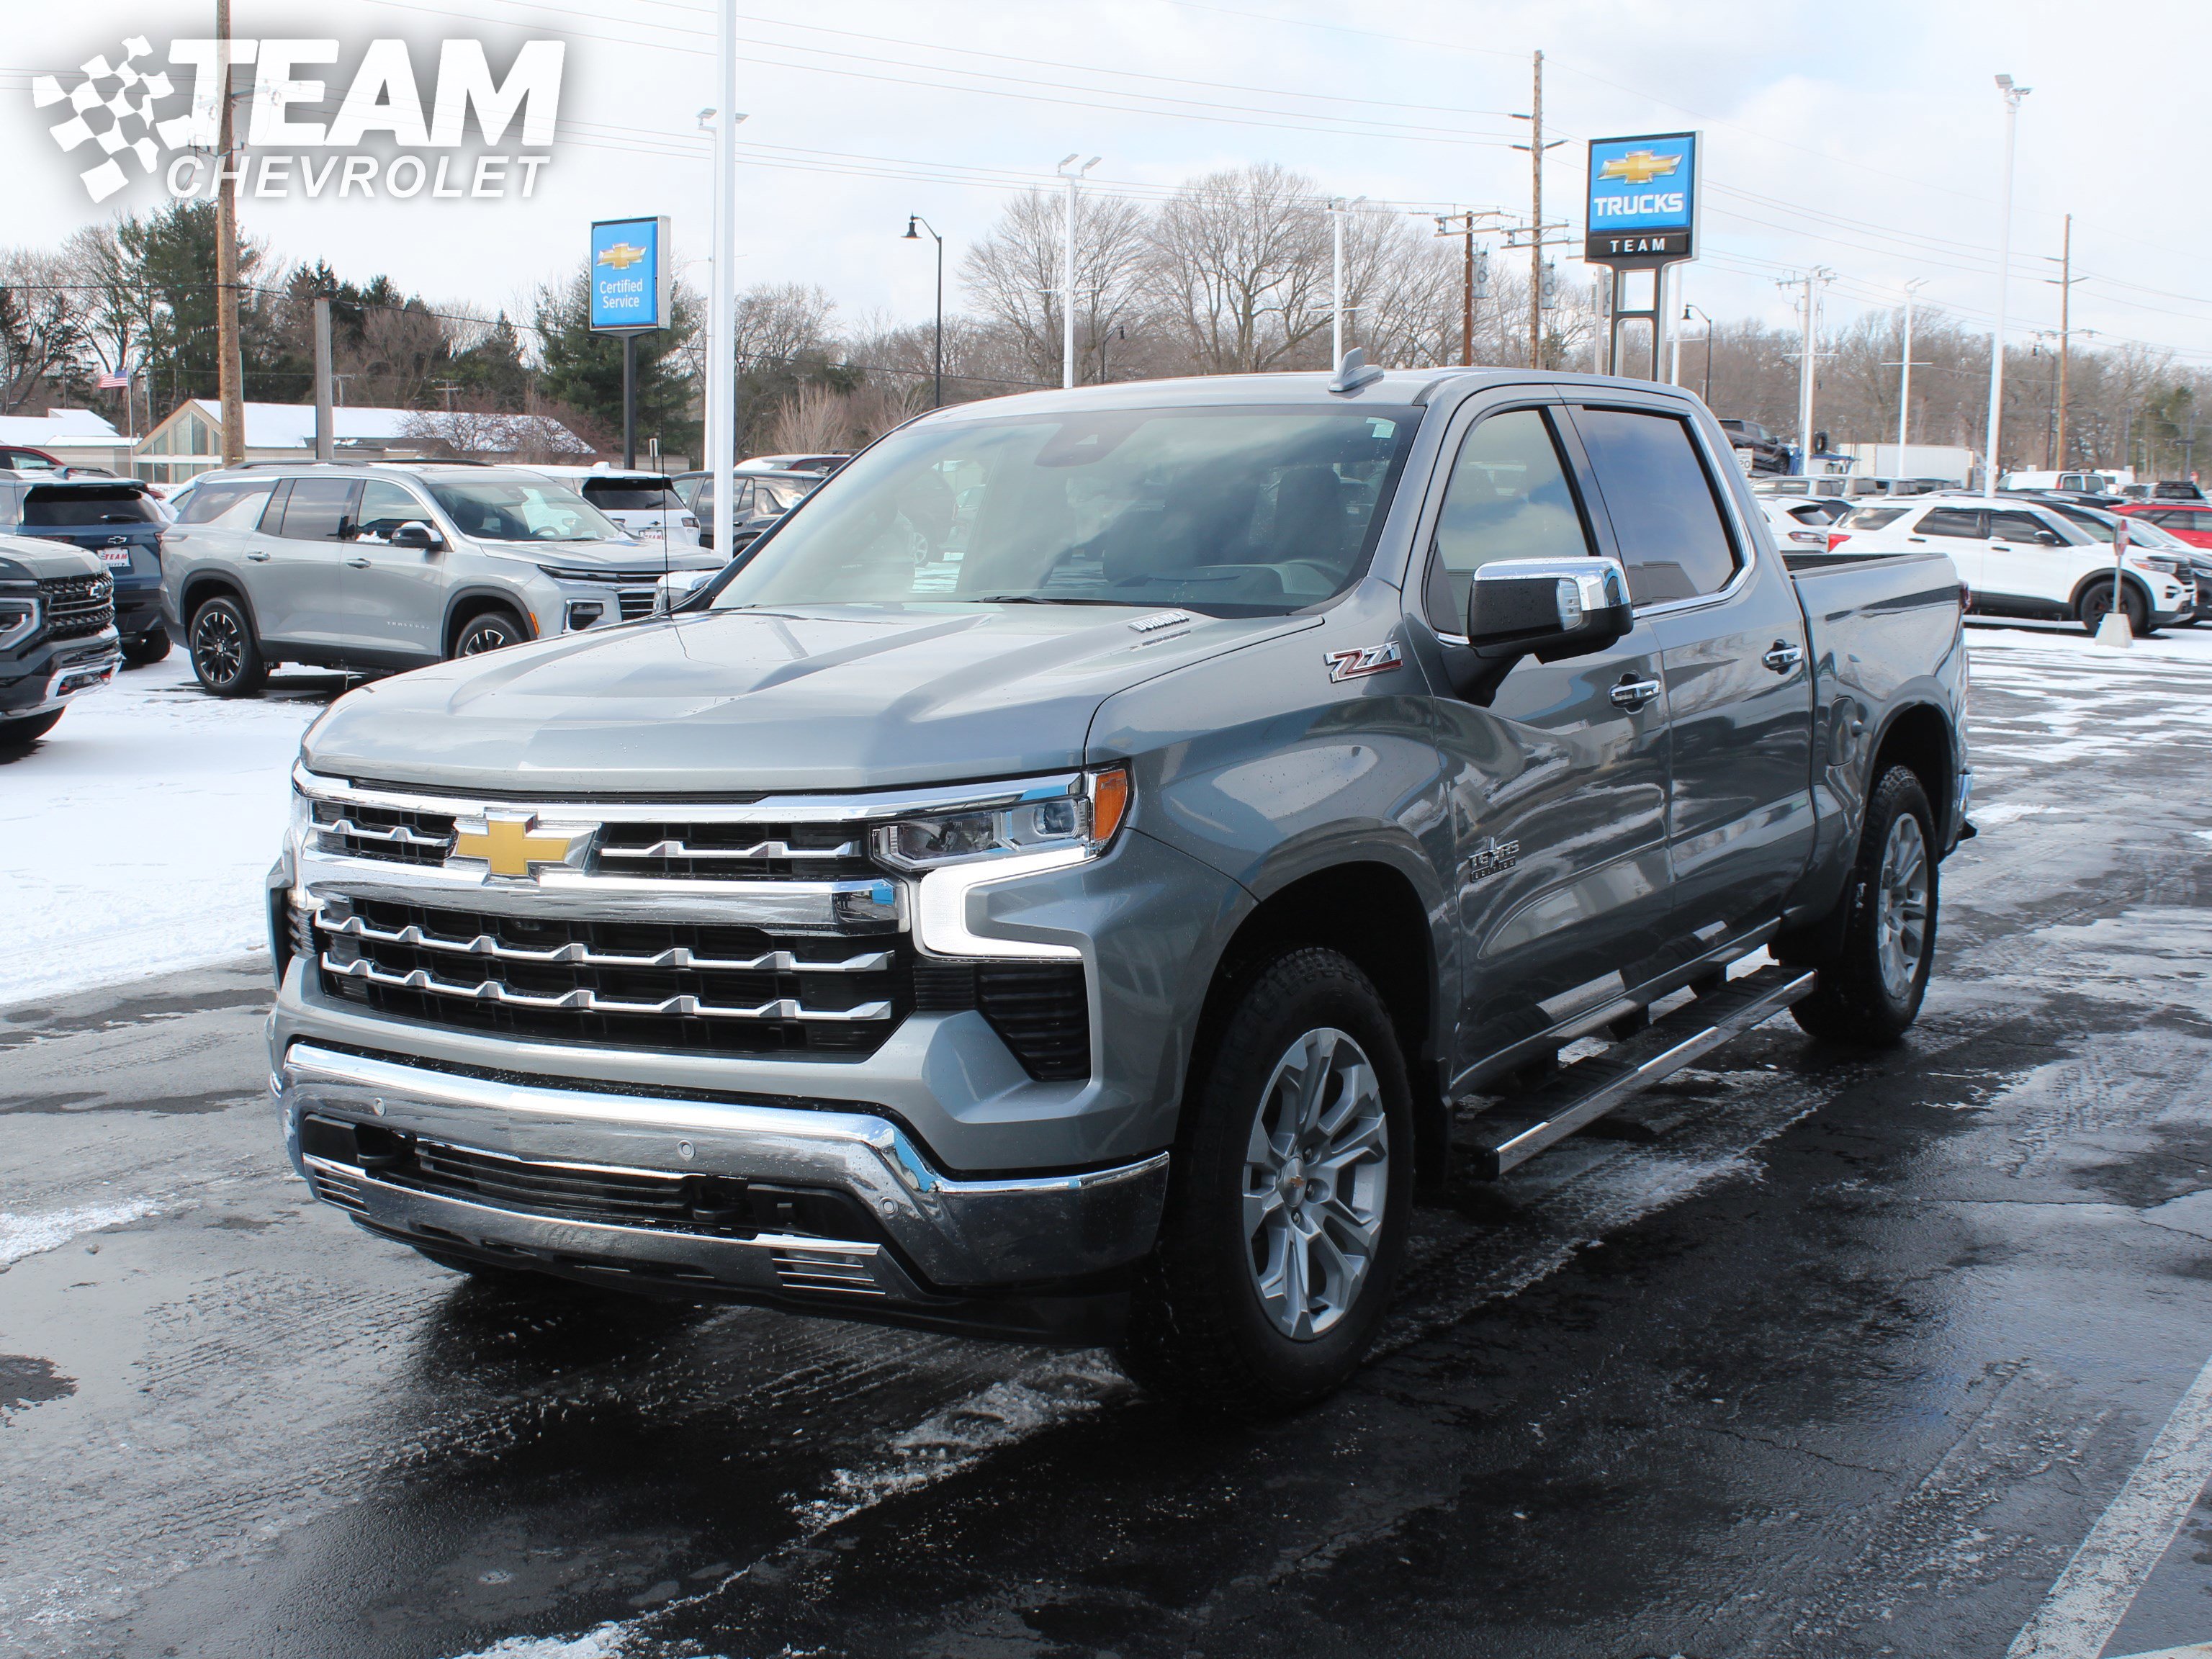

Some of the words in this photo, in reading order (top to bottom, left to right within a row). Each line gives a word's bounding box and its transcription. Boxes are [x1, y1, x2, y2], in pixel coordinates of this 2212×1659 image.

[1593, 193, 1683, 217] TRUCKS
[1610, 238, 1666, 253] TEAM
[600, 278, 643, 294] Certified
[603, 295, 640, 309] Service
[1128, 611, 1190, 633] DURAMAX
[1324, 640, 1403, 683] Z71
[1474, 858, 1515, 880] EDITION
